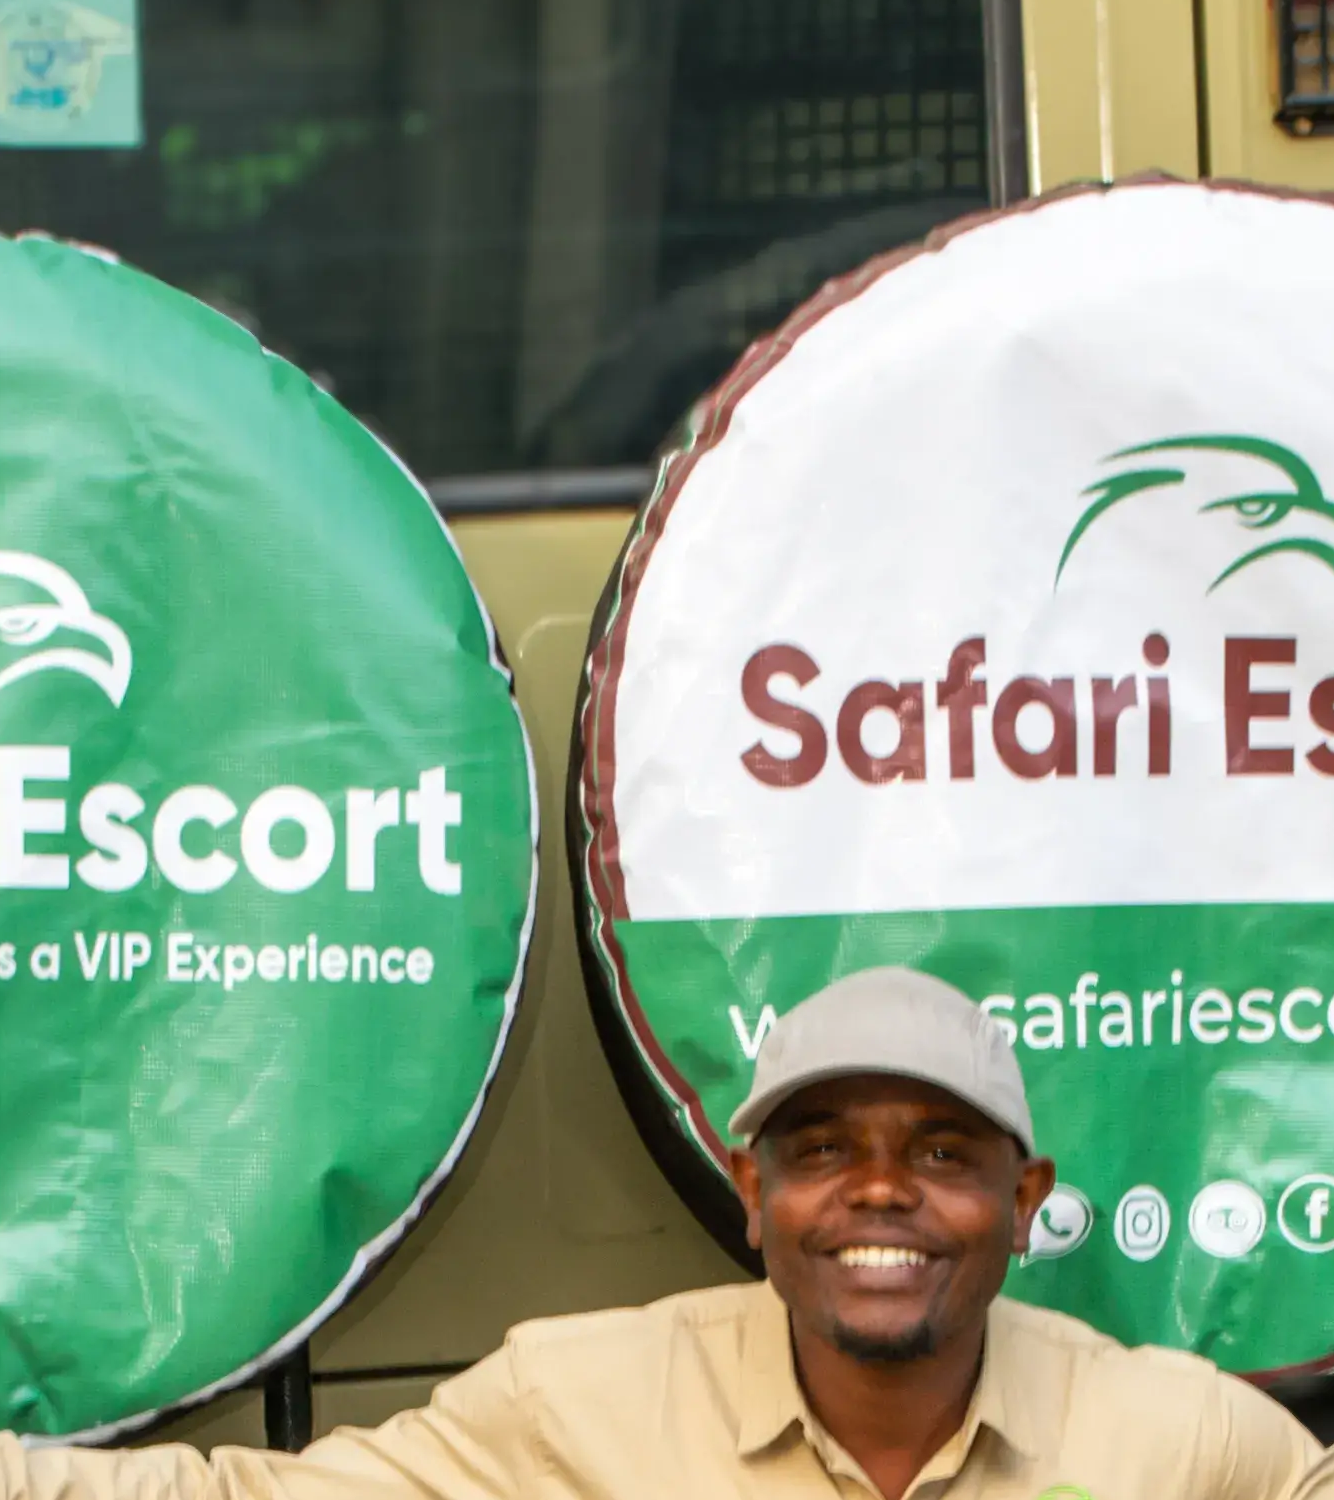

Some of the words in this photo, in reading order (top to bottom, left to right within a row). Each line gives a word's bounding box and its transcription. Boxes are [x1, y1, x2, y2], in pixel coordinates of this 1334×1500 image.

[739, 632, 1173, 790] Safari
[29, 940, 61, 981] a
[73, 930, 152, 982] VIP
[166, 932, 435, 991] Experience
